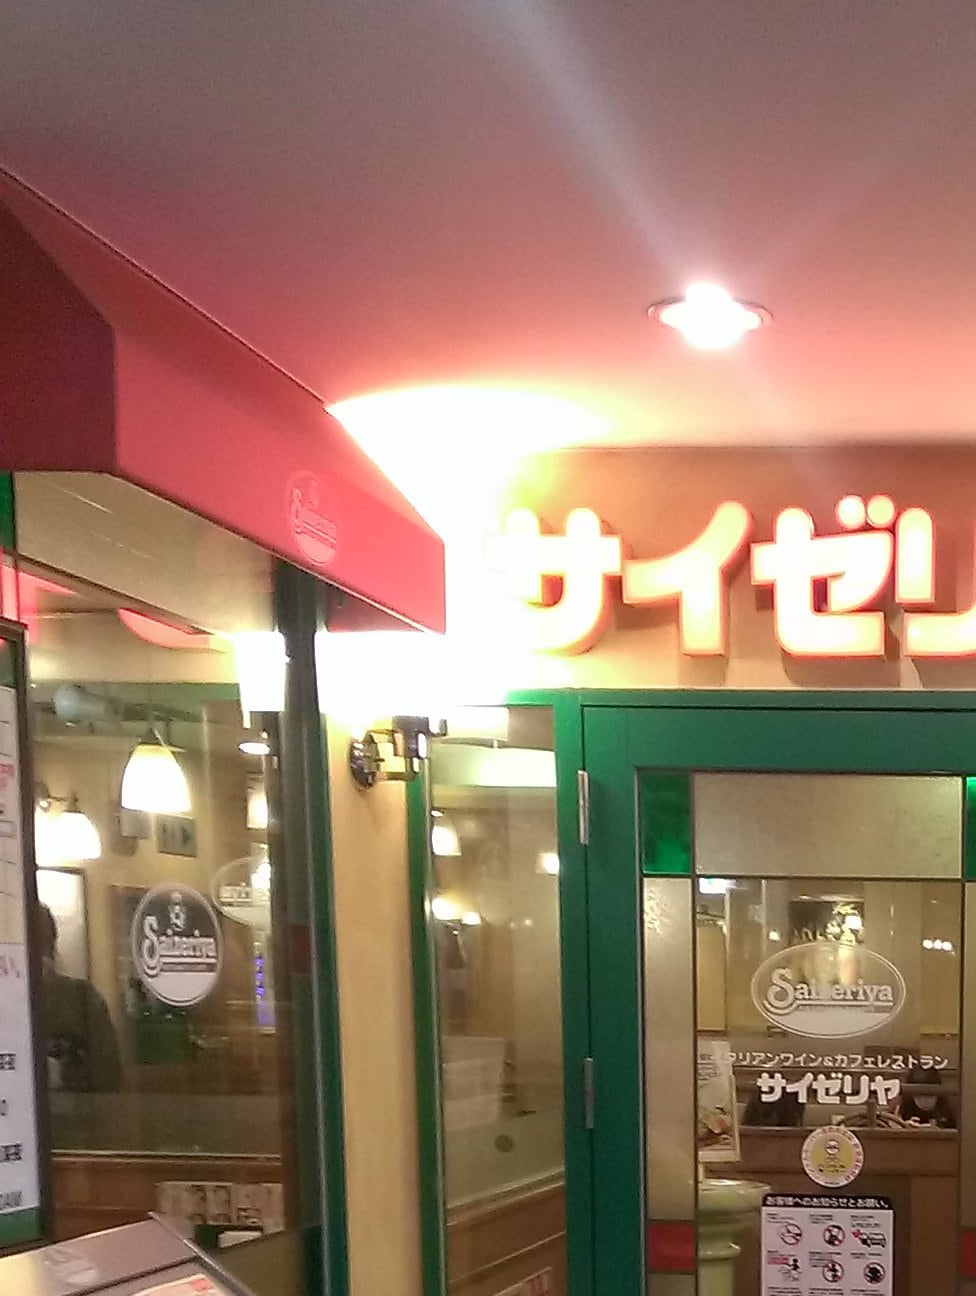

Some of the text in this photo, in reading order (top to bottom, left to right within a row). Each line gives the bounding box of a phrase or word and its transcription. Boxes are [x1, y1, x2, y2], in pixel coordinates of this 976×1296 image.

[766, 967, 894, 1010] Saieriya
[756, 1072, 900, 1105] サイゼリヤ
